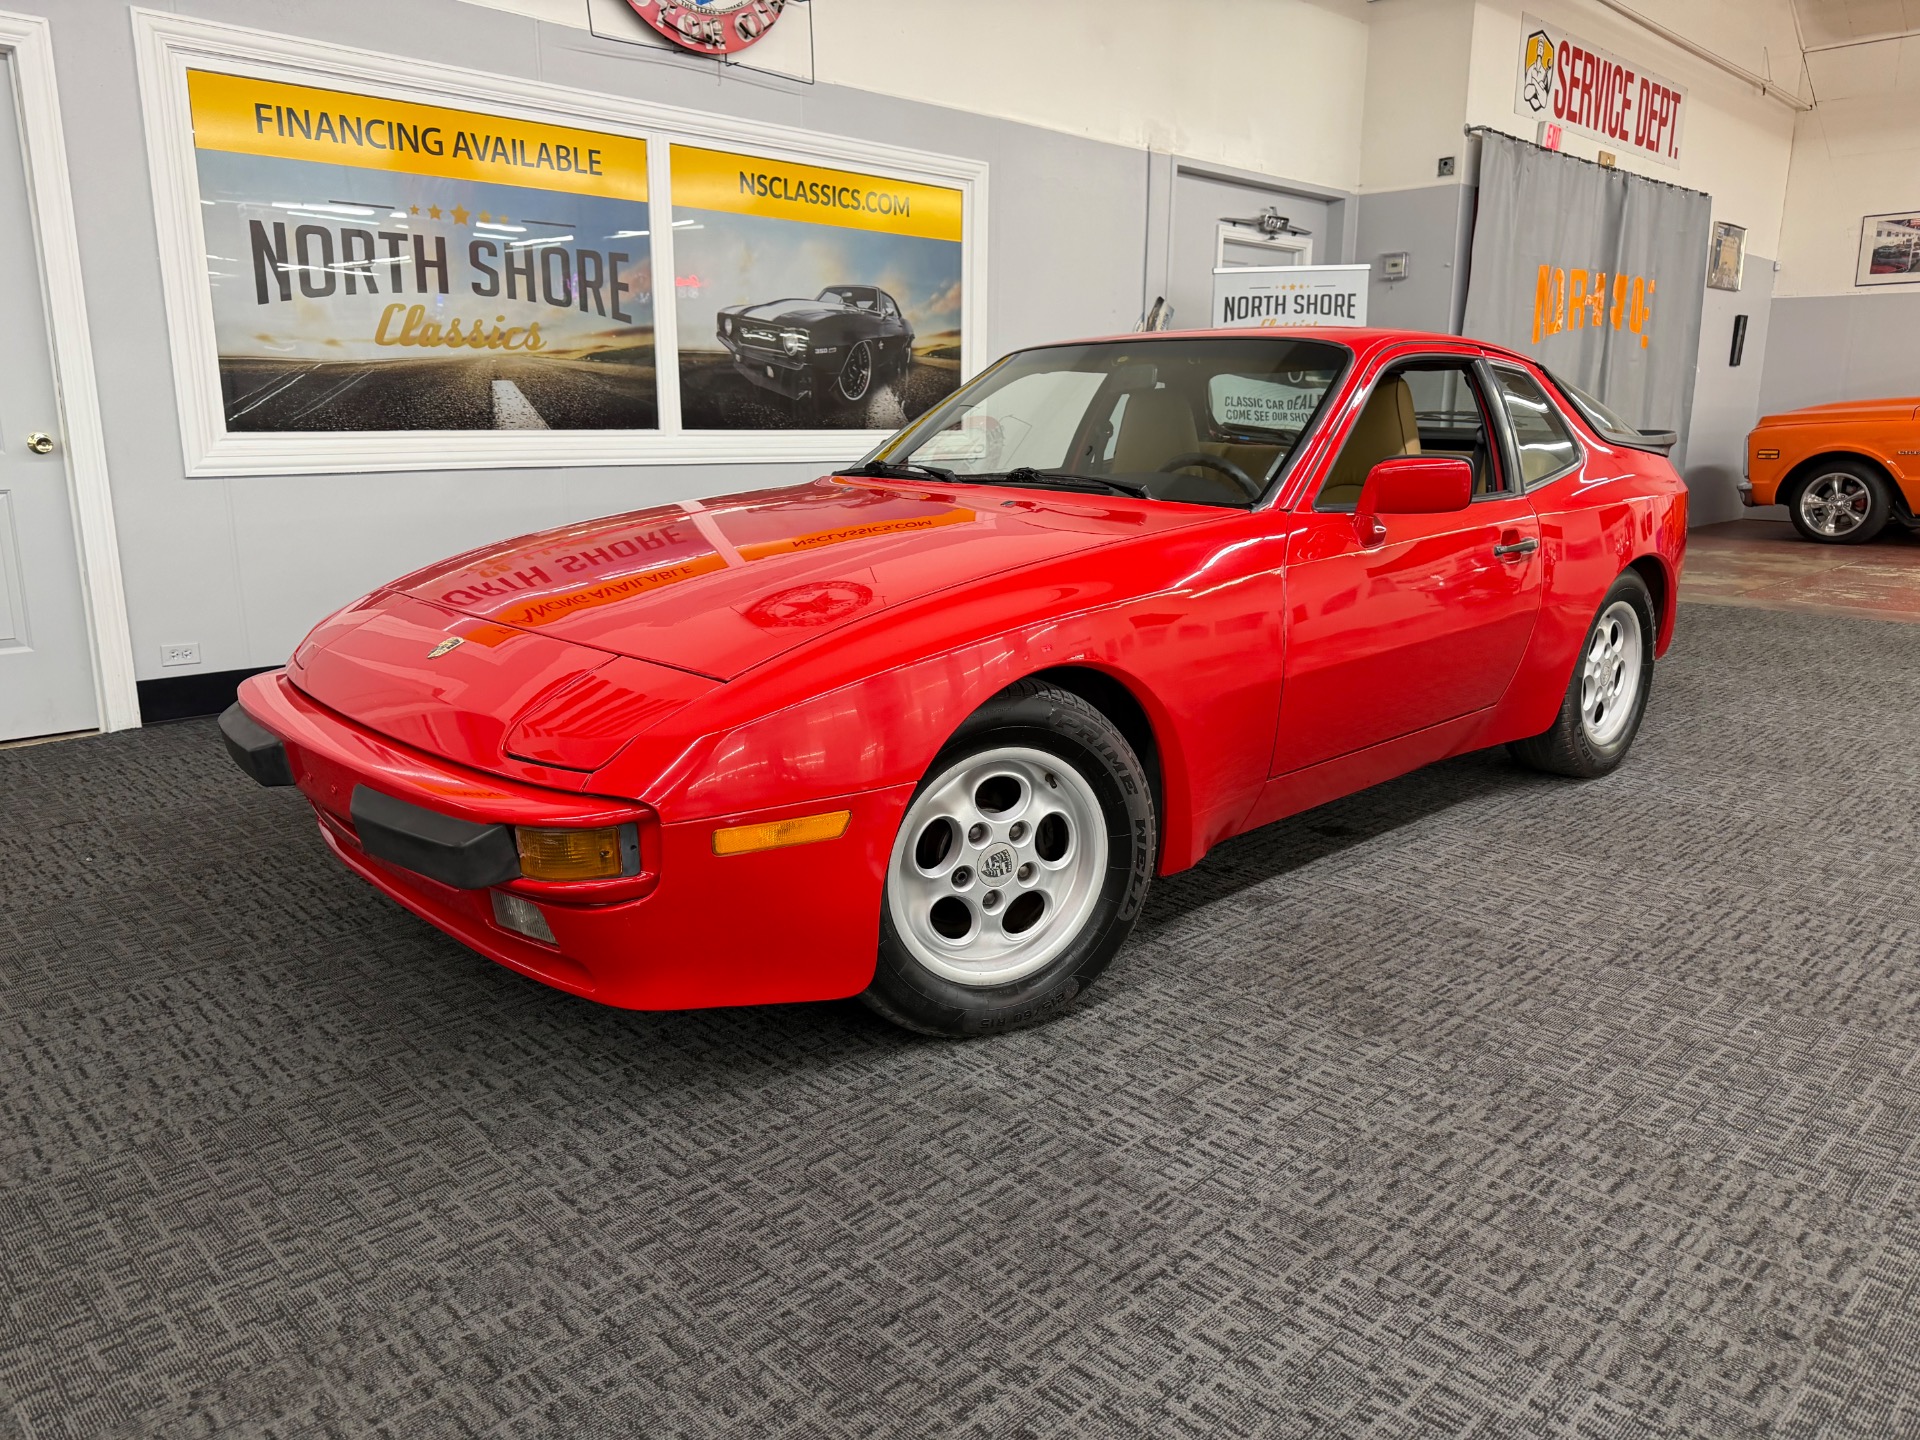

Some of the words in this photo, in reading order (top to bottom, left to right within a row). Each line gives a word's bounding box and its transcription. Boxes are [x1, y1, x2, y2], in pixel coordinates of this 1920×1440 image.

[1554, 40, 1635, 143] SERVICE
[1635, 77, 1682, 160] DEPT.
[254, 103, 443, 156] FINANCING
[452, 131, 603, 176] AVAILABLE
[739, 171, 911, 218] NSCLASSICS.COM
[248, 219, 449, 305] NORTH
[469, 239, 632, 325] SHORE
[374, 302, 547, 352] Classics
[1224, 295, 1287, 323] NORTH
[1293, 293, 1356, 320] SHORE
[1224, 396, 1263, 408] CLASSIC
[1266, 399, 1284, 410] CAR
[1226, 409, 1252, 421] COME
[1254, 410, 1270, 422] SEE
[1272, 411, 1288, 421] OUR
[1290, 412, 1312, 423] SHO
